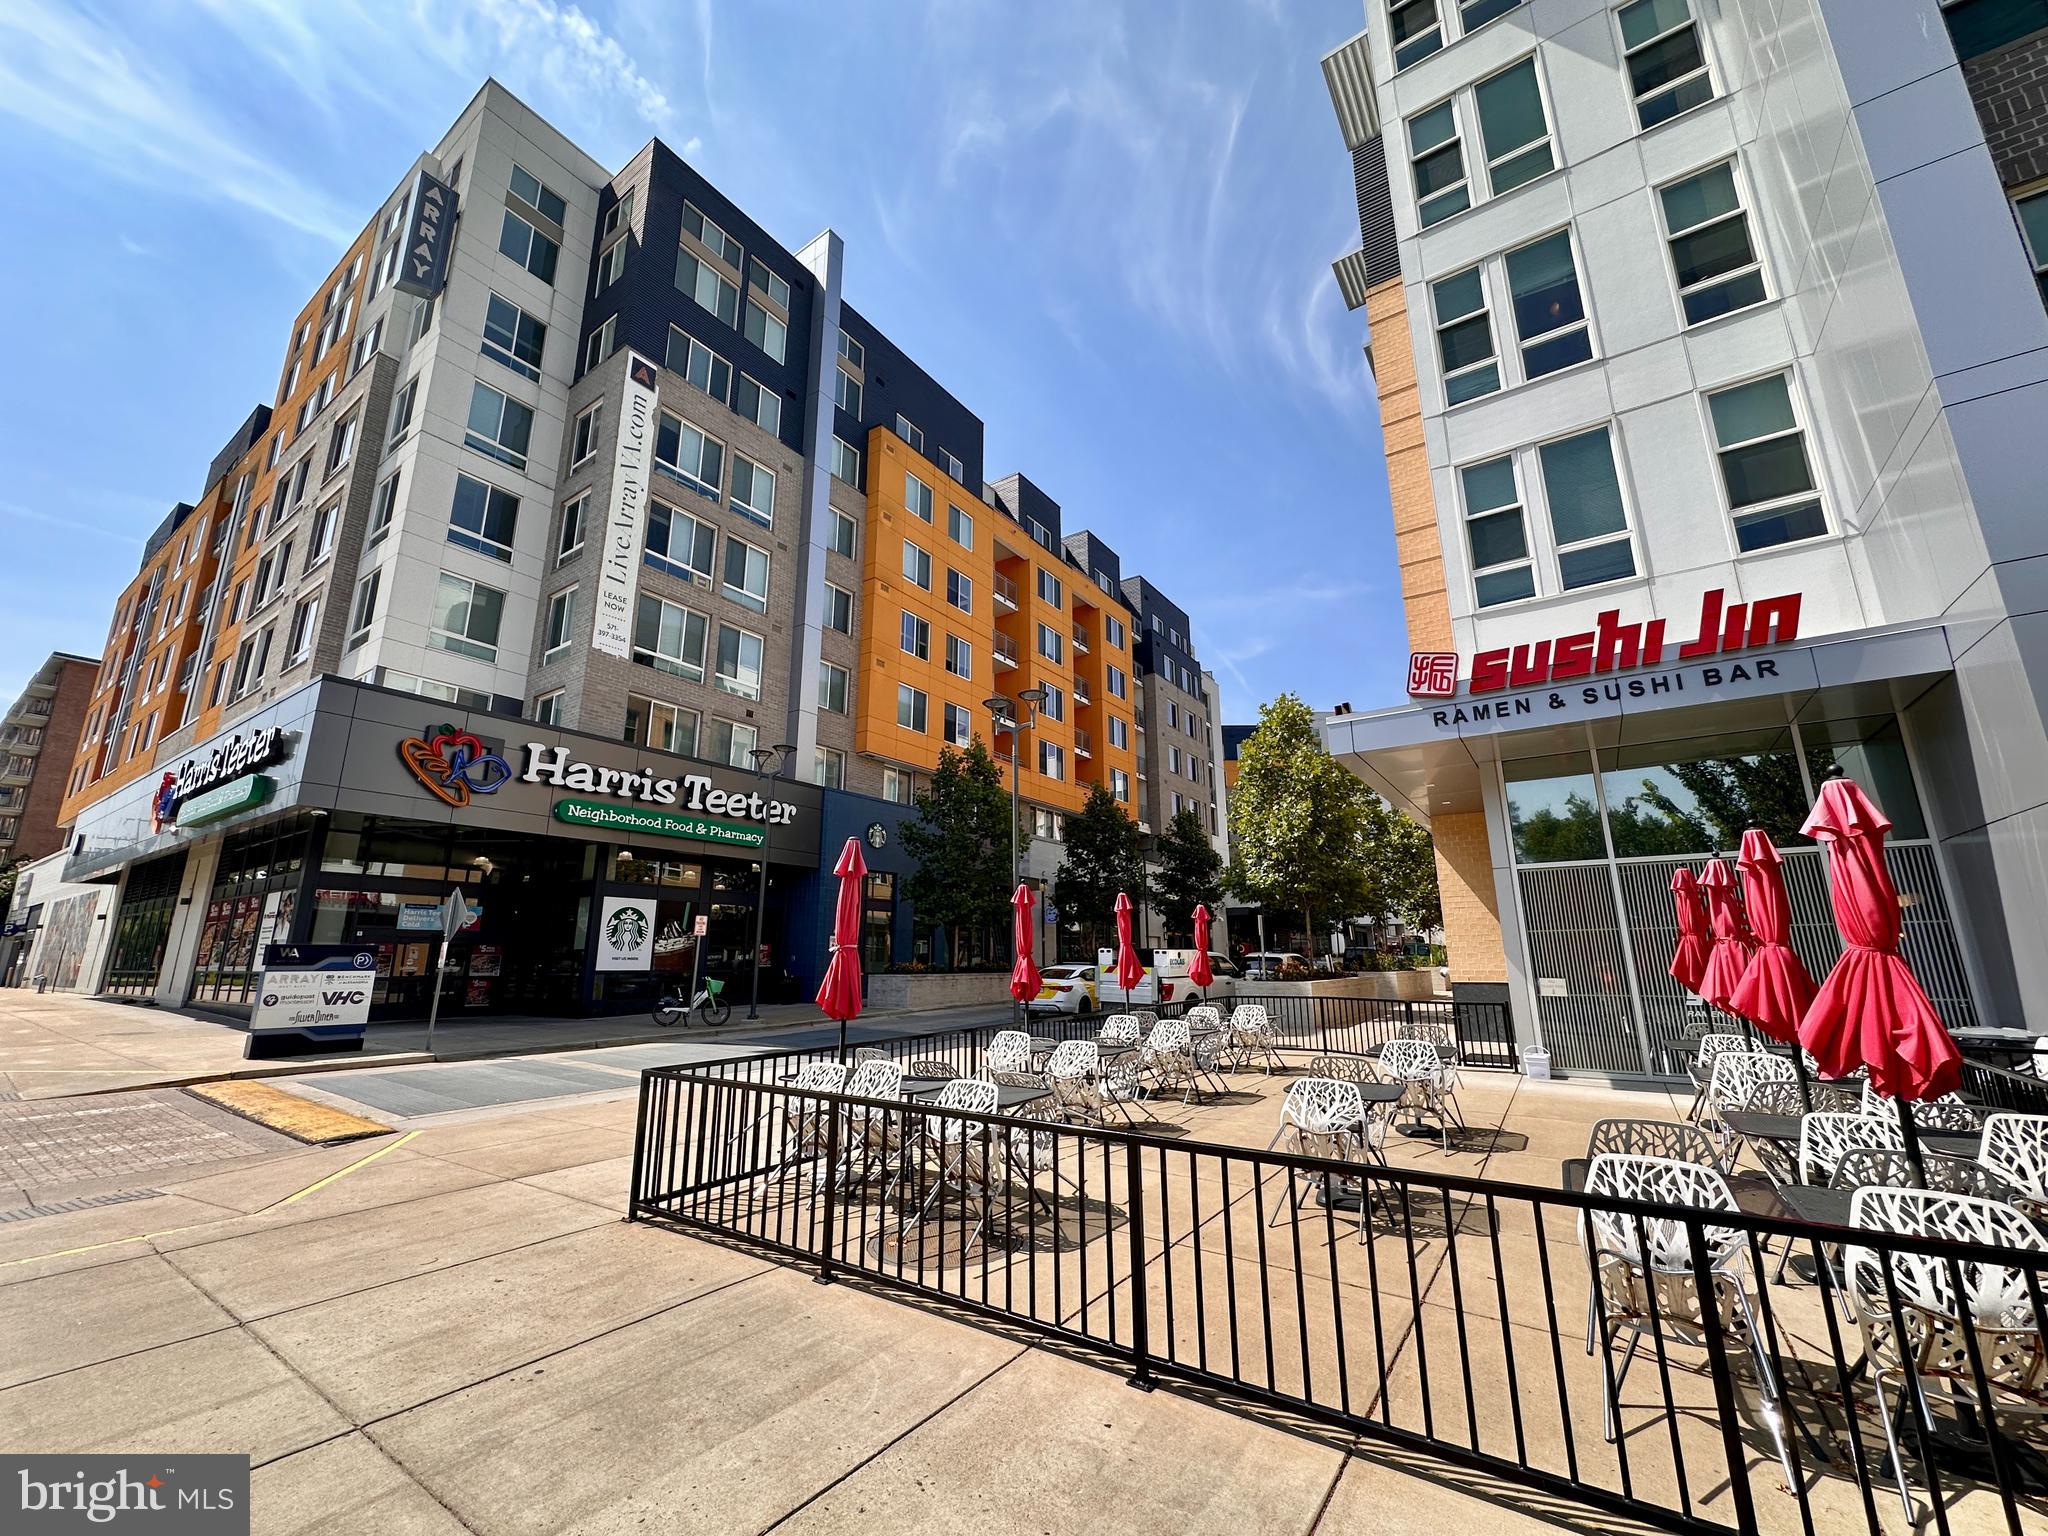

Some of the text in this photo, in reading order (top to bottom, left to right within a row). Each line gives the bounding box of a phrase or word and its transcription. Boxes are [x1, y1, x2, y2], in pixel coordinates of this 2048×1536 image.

[413, 187, 444, 278] ARRAY
[603, 591, 628, 604] LEASE
[604, 601, 625, 612] NOW
[1470, 609, 1667, 694] sushi
[1432, 659, 1779, 727] RAMEN & SUSHI BAR
[173, 726, 282, 799] Harris Teeter
[522, 742, 797, 824] Harris Teeter
[567, 804, 764, 845] Neighborhood Food & Pharmacy
[267, 974, 320, 985] ARRAY
[356, 956, 365, 966] P
[322, 990, 365, 1006] VHC
